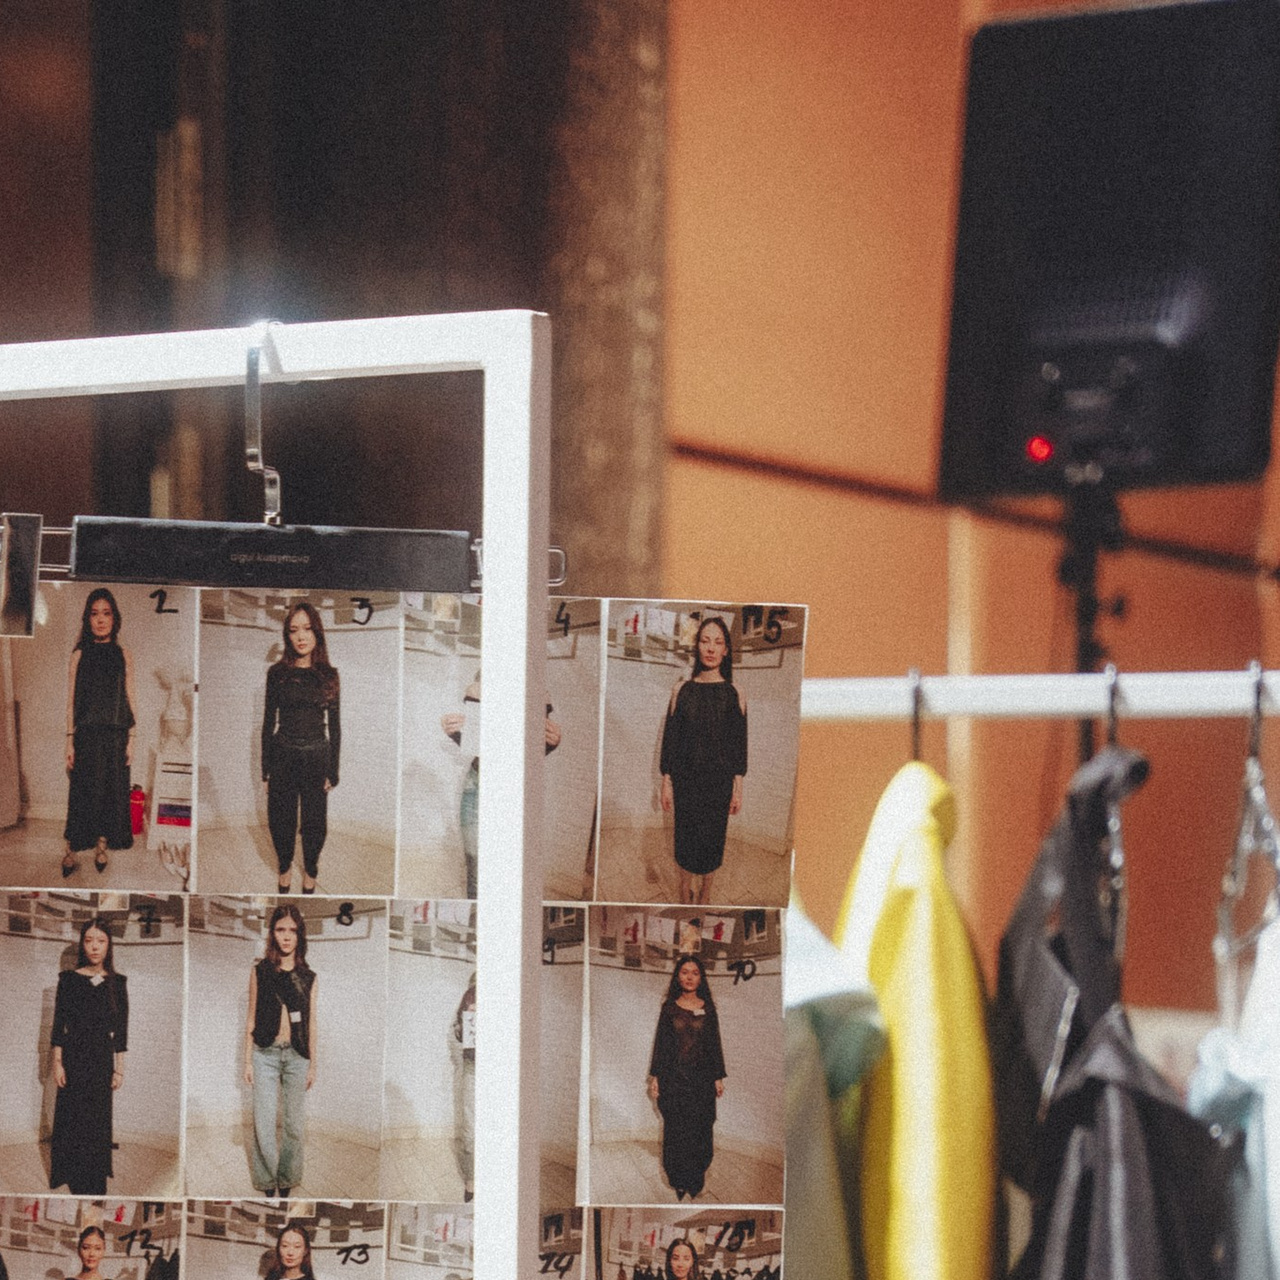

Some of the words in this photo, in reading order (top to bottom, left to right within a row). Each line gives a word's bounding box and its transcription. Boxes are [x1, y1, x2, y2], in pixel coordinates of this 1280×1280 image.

[149, 589, 178, 613] 2
[350, 597, 373, 625] 3
[554, 601, 570, 637] 4
[763, 607, 788, 643] 5
[336, 902, 354, 926] 8
[337, 1244, 370, 1265] 13
[539, 1252, 574, 1279] 14
